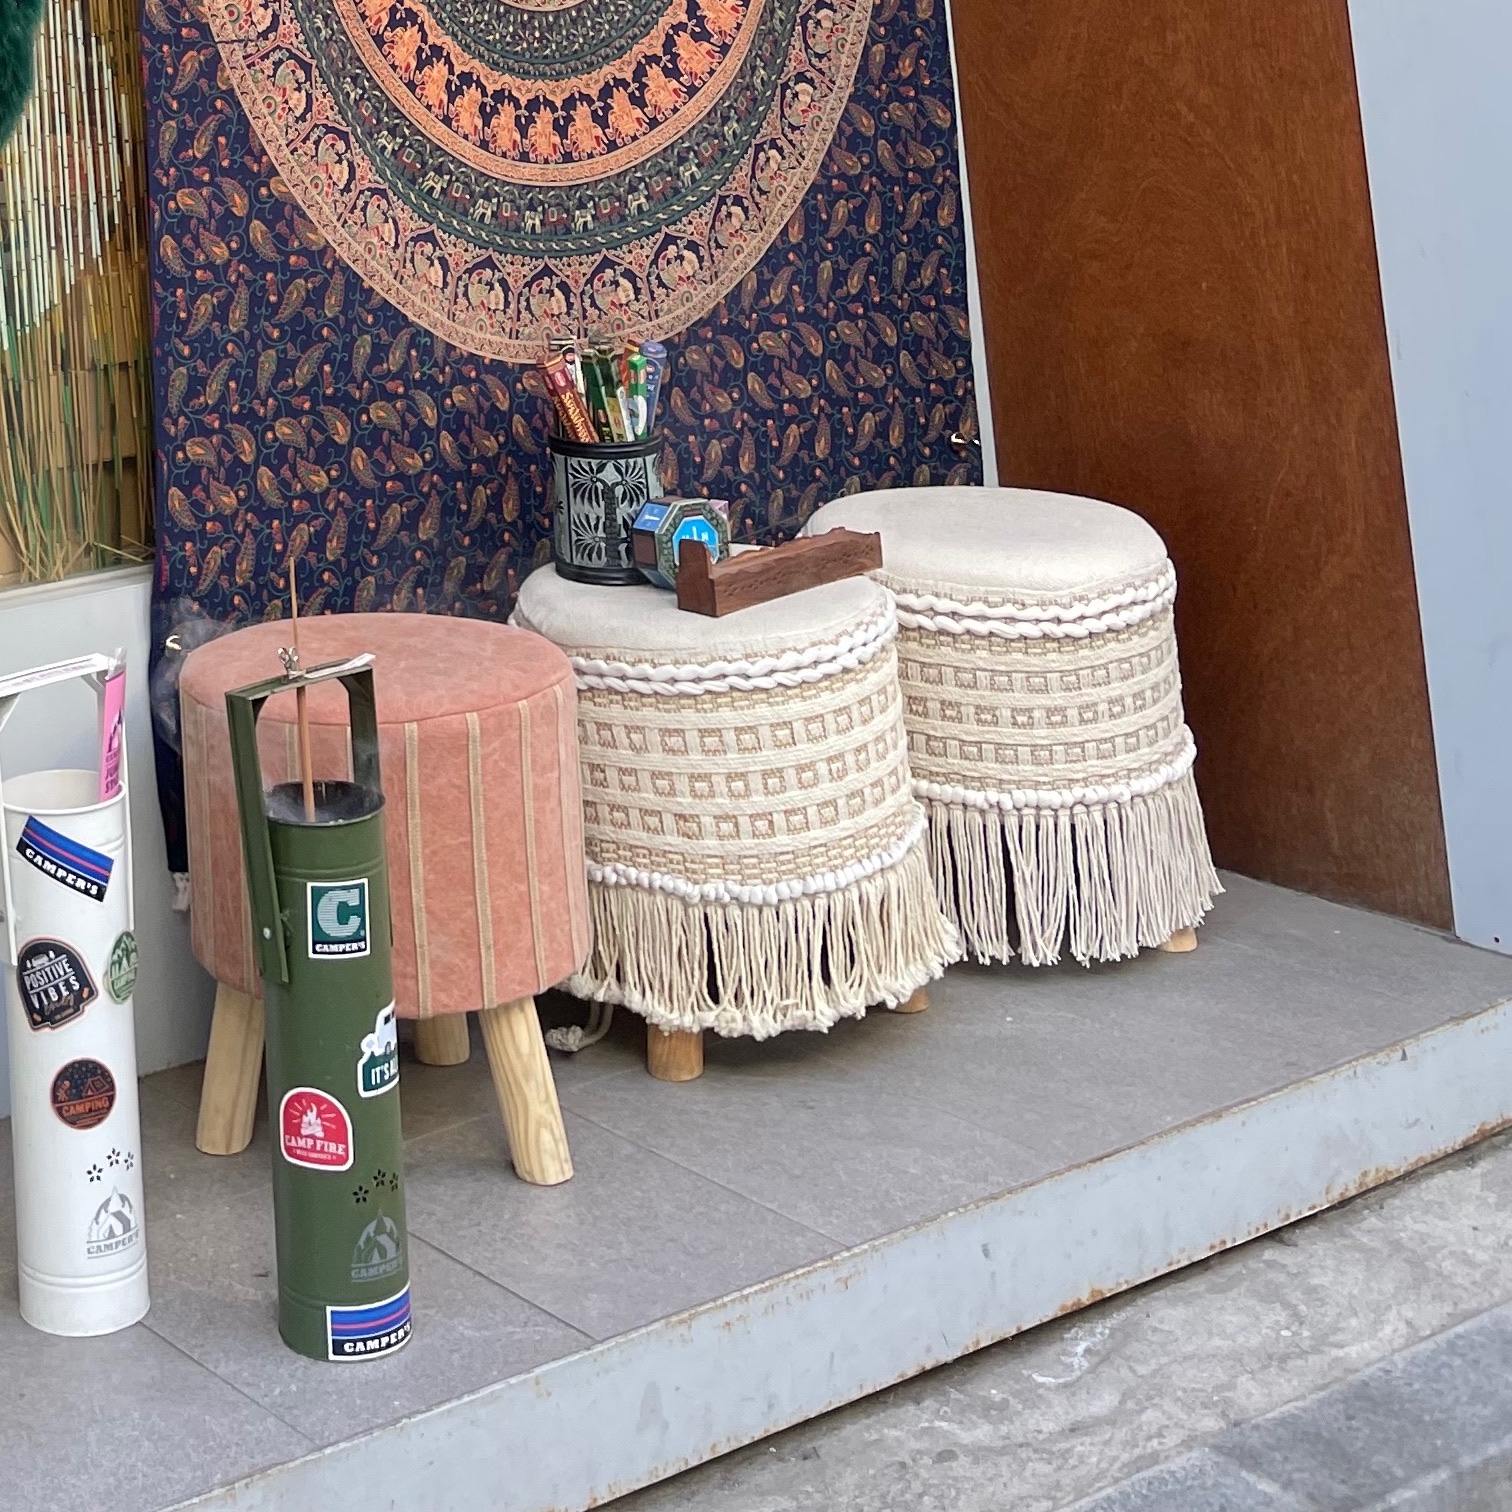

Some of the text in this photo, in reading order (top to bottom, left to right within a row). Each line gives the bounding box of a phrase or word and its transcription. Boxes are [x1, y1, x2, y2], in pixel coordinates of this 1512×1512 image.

[25, 848, 99, 895] CAMPER'S
[316, 888, 362, 937] C
[315, 940, 366, 953] CAMPER'S
[23, 957, 74, 991] POSITIVE
[29, 975, 80, 1009] VIBES
[285, 1134, 314, 1149] CAMP
[315, 1139, 346, 1156] FIRE
[343, 1320, 411, 1353] CAMPER'S
